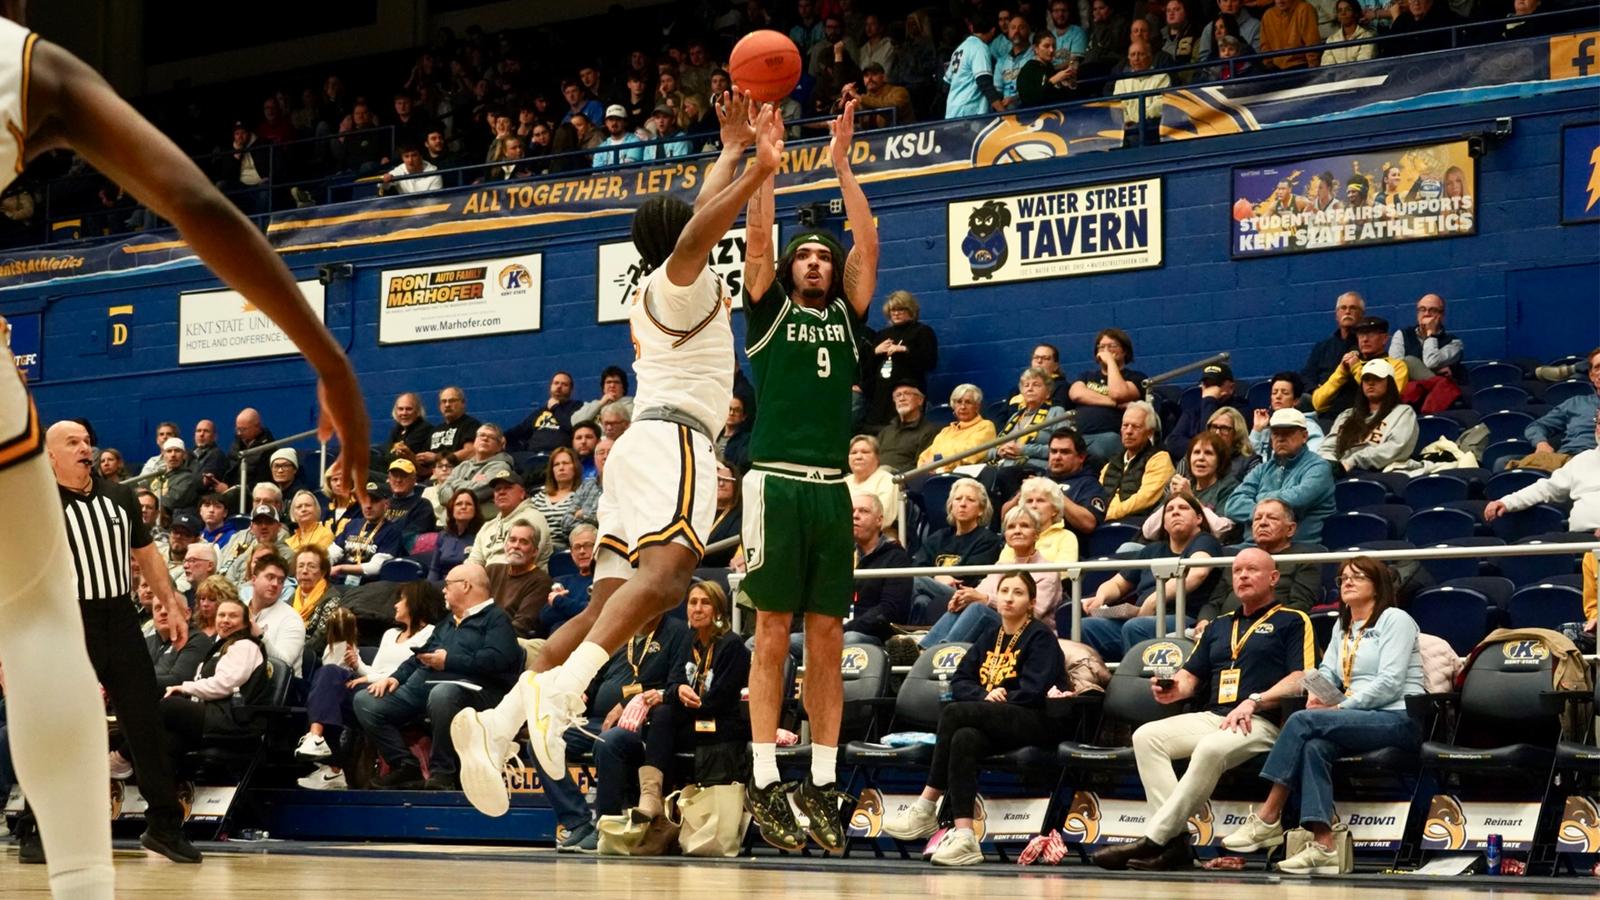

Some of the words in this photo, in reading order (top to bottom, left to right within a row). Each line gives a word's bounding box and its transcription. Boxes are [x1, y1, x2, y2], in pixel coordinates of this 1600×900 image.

[462, 189, 500, 214] ALL
[507, 175, 628, 209] TOGETHER,
[635, 164, 697, 195] LET'S
[745, 140, 876, 176] FRWAD.
[884, 130, 942, 161] KSU.
[1017, 193, 1078, 218] WATER
[1085, 184, 1148, 211] STREET
[1240, 211, 1311, 232] STUDENT
[1314, 204, 1383, 225] AFFAIRS
[1385, 195, 1472, 217] SUPPORTS
[1016, 208, 1148, 260] TAVERN
[1239, 230, 1290, 252] KENT
[1295, 223, 1357, 246] STATE
[1360, 212, 1473, 241] ATHLETICS
[390, 273, 429, 293] RON
[435, 271, 454, 284] AUTO
[455, 268, 483, 282] FAMILY
[387, 282, 484, 308] MARHOFER
[112, 323, 128, 346] D
[185, 320, 215, 336] KENT
[215, 318, 244, 334] STATE
[415, 316, 501, 333] www.Marhofer.com
[186, 339, 210, 350] HOTEL
[211, 337, 228, 348] AND
[229, 332, 281, 346] CONFERENCE
[817, 347, 831, 378] 9
[1003, 812, 1030, 821] Kamis
[1118, 814, 1146, 823] Kamis
[1348, 814, 1396, 826] Brown
[1483, 817, 1523, 827] Reinart
